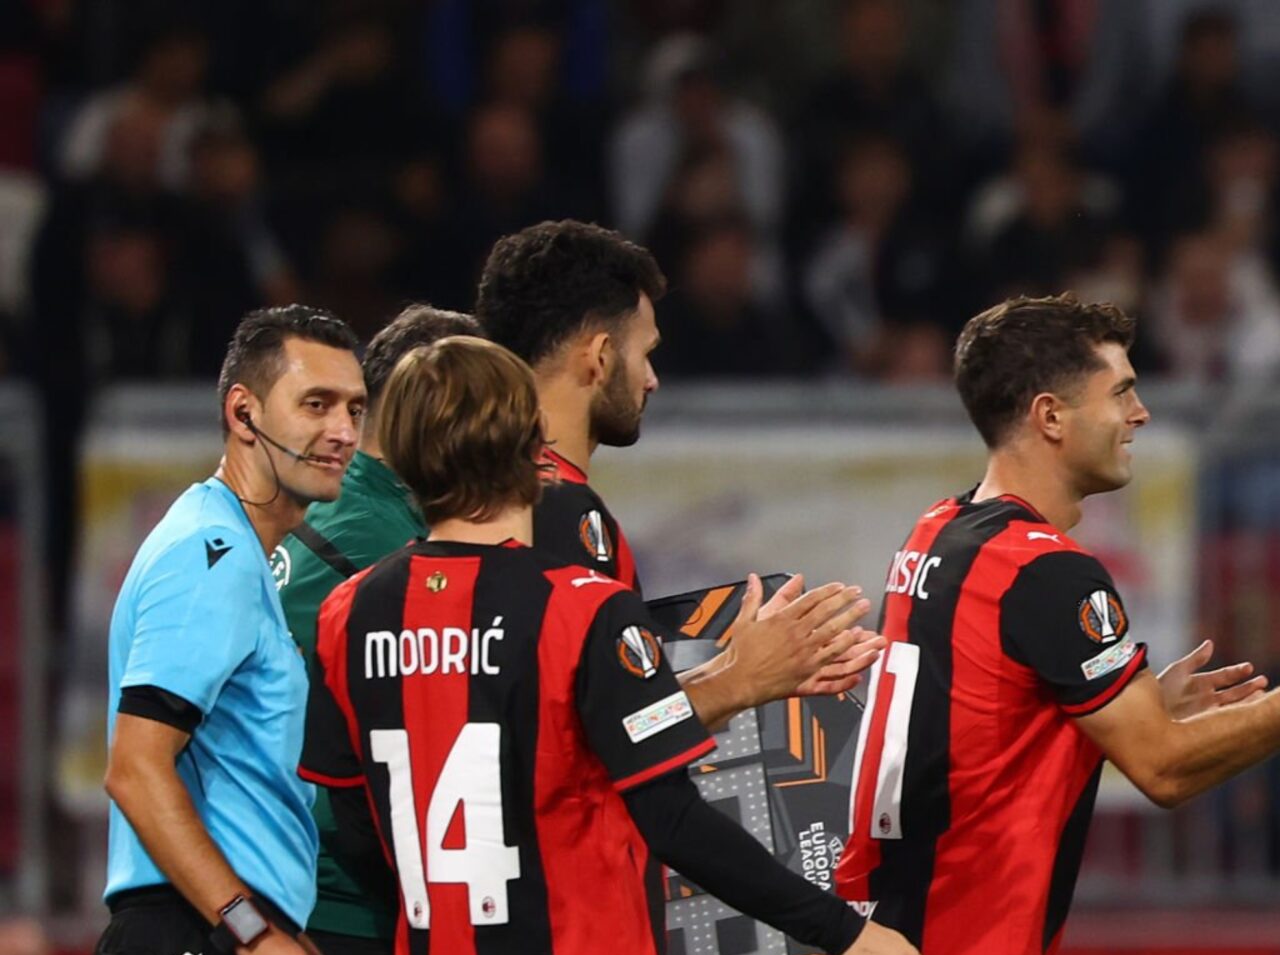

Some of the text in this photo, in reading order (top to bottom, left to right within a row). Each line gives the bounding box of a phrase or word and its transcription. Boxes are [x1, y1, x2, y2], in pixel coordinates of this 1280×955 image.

[365, 616, 504, 679] MODRIĆ
[370, 722, 520, 929] 14
[799, 831, 817, 884] LEAGU
